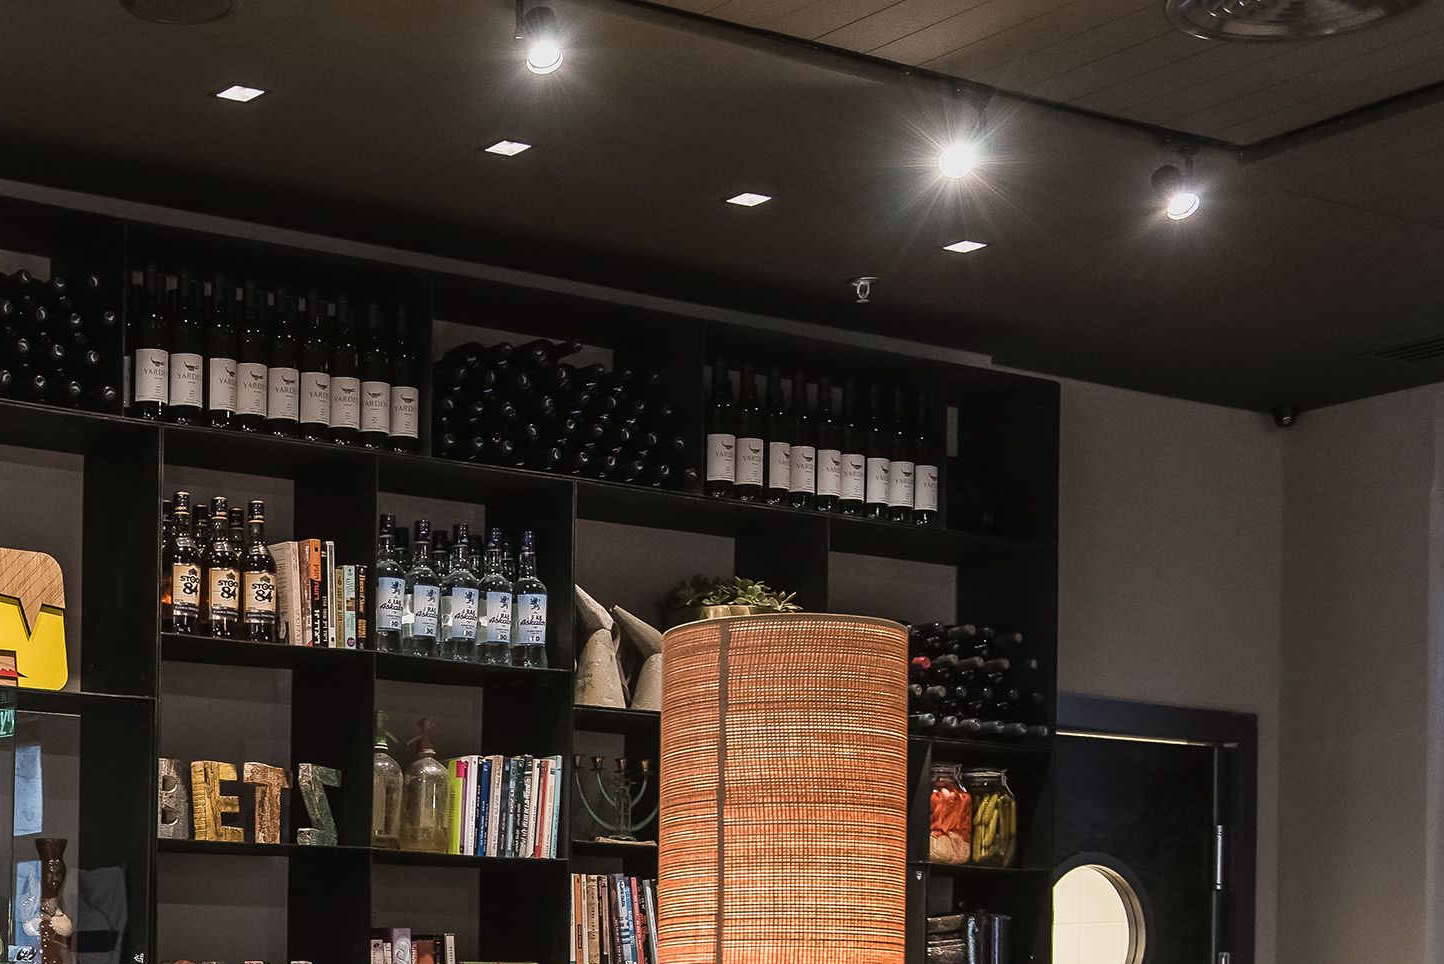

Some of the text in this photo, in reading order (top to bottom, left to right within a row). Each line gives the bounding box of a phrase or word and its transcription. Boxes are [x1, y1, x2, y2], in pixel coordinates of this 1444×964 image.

[180, 575, 200, 584] STOC
[218, 580, 238, 588] STOC
[251, 583, 274, 591] STOC
[182, 582, 198, 596] 84
[221, 586, 237, 600] 84
[254, 589, 273, 602] 84
[380, 602, 403, 610] Askalo
[415, 610, 438, 618] Askalo
[455, 612, 478, 620] Askalo
